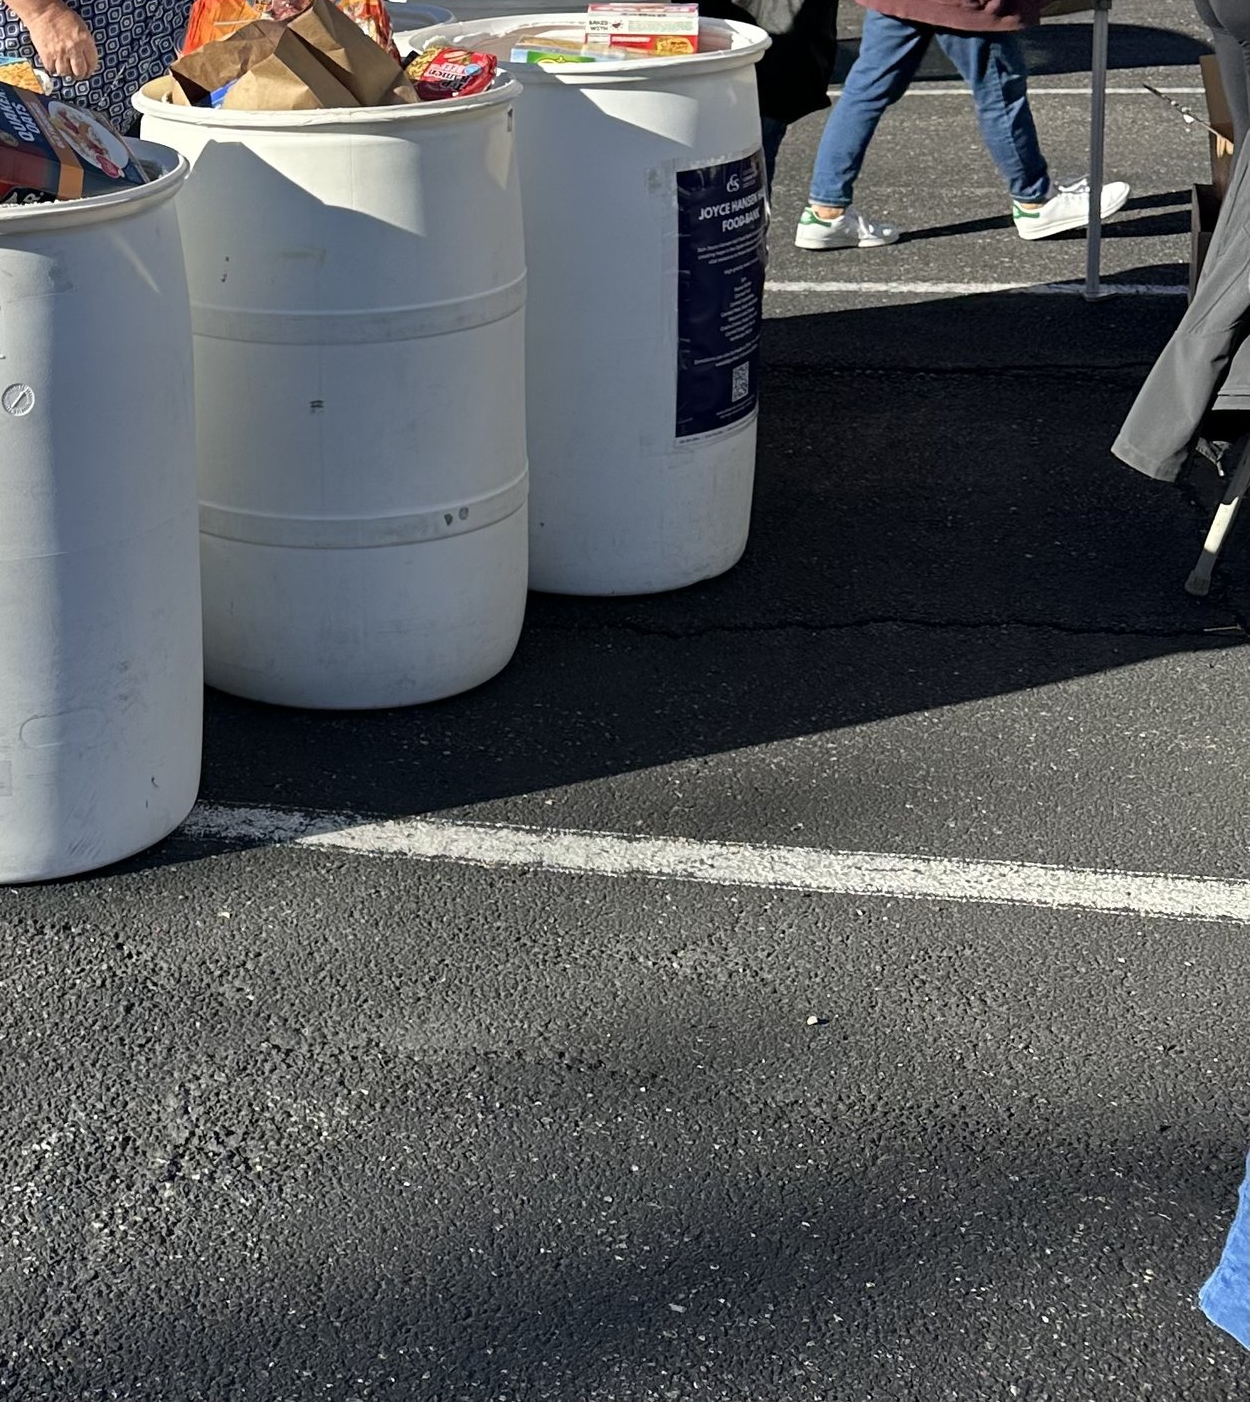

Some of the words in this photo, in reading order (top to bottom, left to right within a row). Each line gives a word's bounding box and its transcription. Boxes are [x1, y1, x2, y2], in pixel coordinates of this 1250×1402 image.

[11, 101, 41, 134] OATS
[698, 202, 731, 221] JOYCE
[731, 192, 758, 213] HANSEN
[721, 215, 744, 233] FOOD
